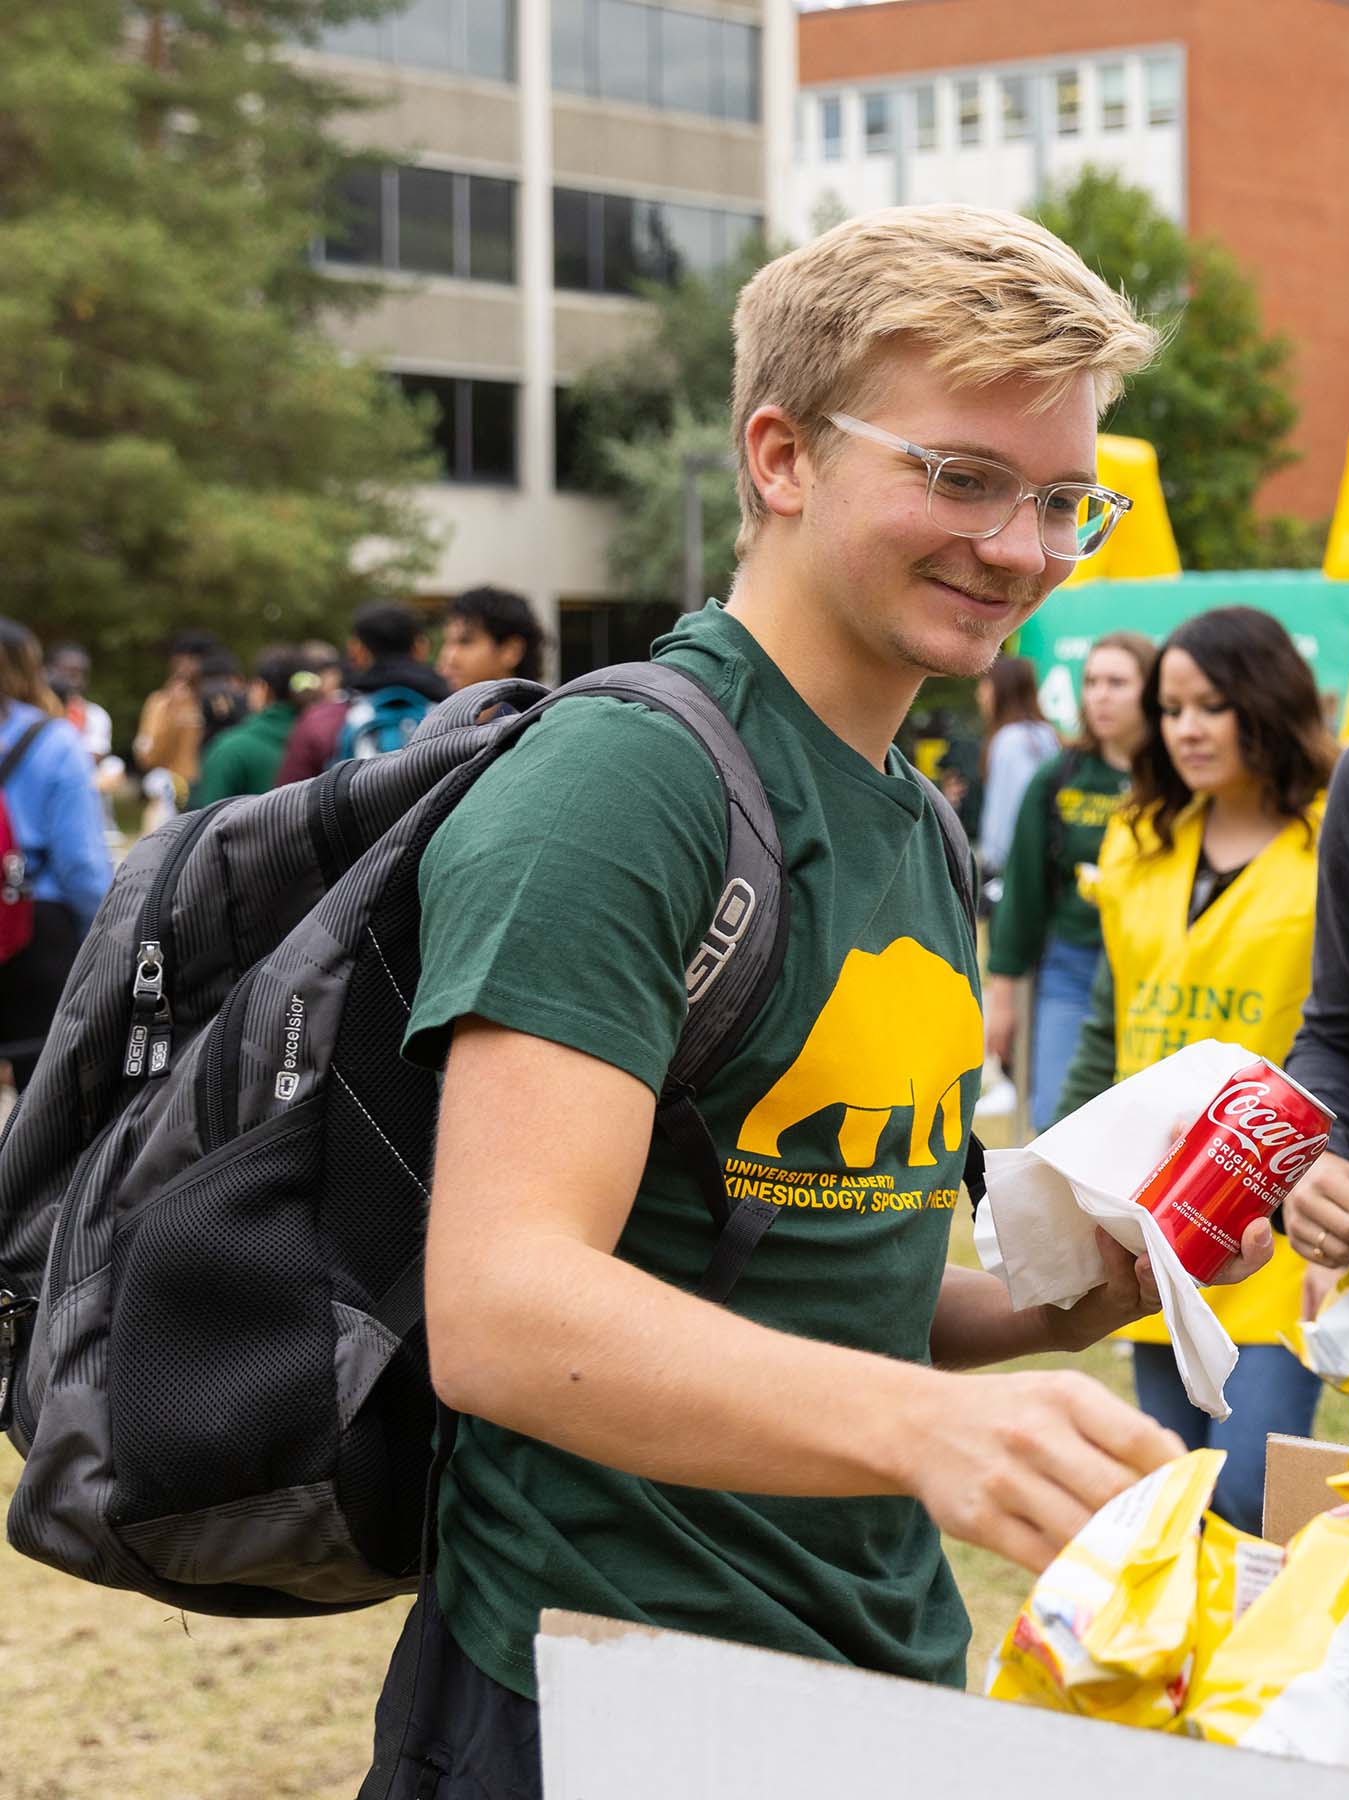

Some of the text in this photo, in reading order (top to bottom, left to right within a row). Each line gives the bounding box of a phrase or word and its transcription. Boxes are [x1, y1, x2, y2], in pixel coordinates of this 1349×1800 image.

[685, 877, 756, 1005] GIO
[126, 1025, 148, 1076] OGIO
[283, 994, 305, 1069] excelsior
[725, 1157, 818, 1187] UNIVERSITY
[819, 1172, 838, 1189] OF
[1207, 1147, 1242, 1177] GOÛT
[1213, 1137, 1289, 1199] ORIGINAL TAS
[723, 1174, 867, 1215] KINESIOLOGY,
[871, 1190, 923, 1213] SPORT
[1171, 1201, 1202, 1229] Délicieux
[1182, 1200, 1212, 1227] Delicious
